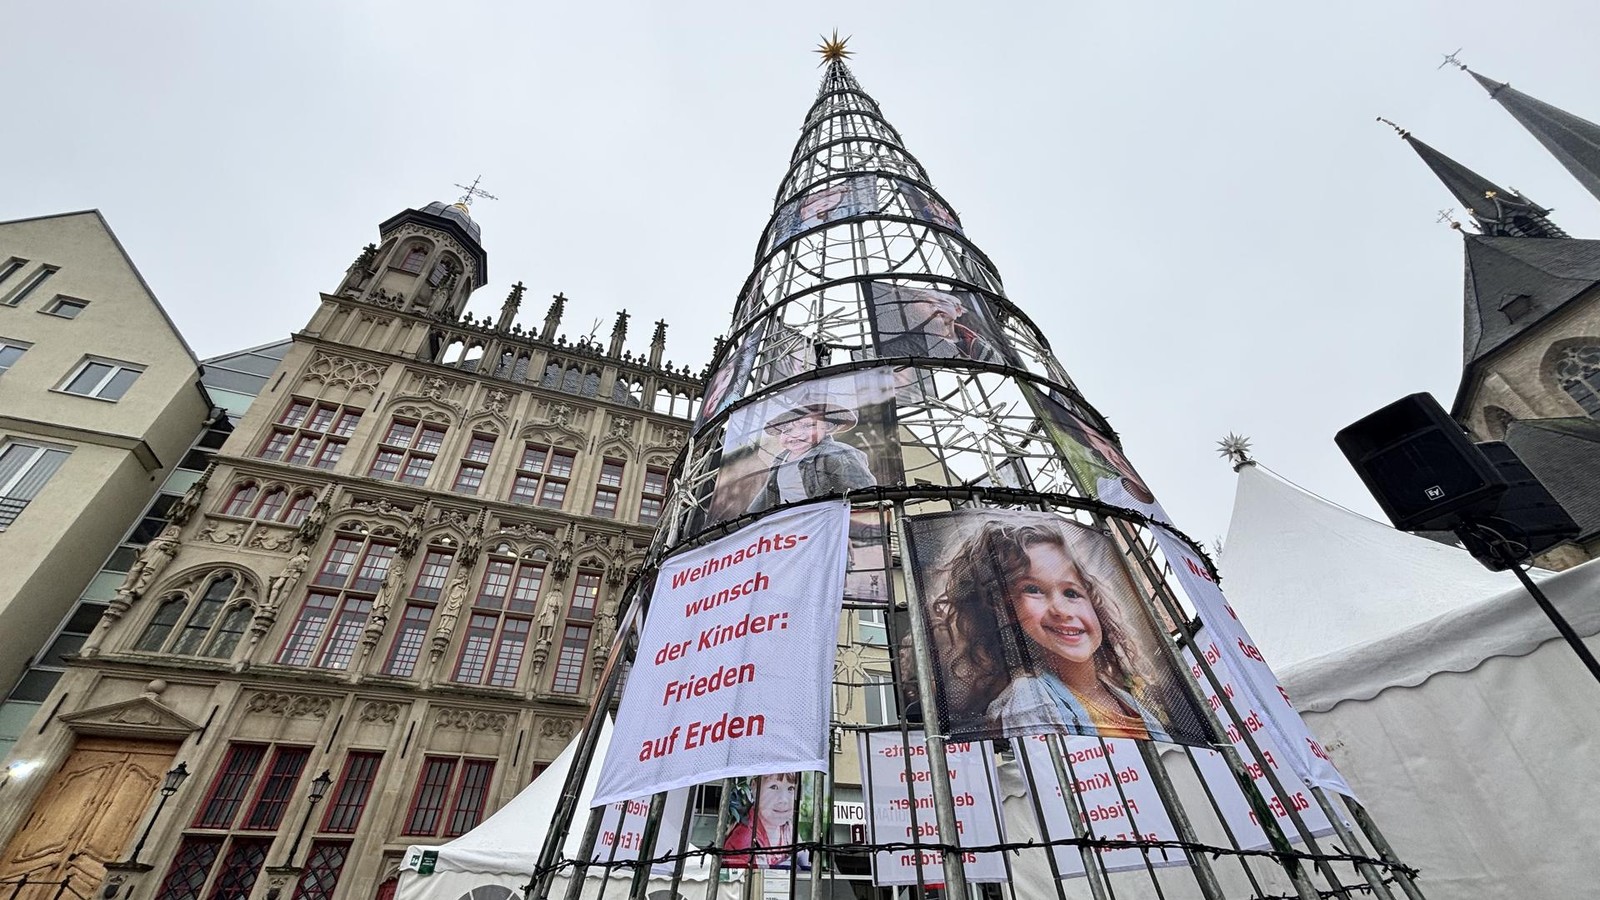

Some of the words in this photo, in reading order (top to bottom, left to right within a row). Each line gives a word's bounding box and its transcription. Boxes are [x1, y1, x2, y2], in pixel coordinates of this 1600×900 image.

[672, 533, 808, 590] Weihnachts-
[685, 572, 769, 617] wunsch
[655, 640, 690, 665] der
[697, 612, 788, 652] Kinder:
[662, 661, 755, 706] Frieden
[639, 727, 680, 762] auf
[684, 712, 766, 750] Erden
